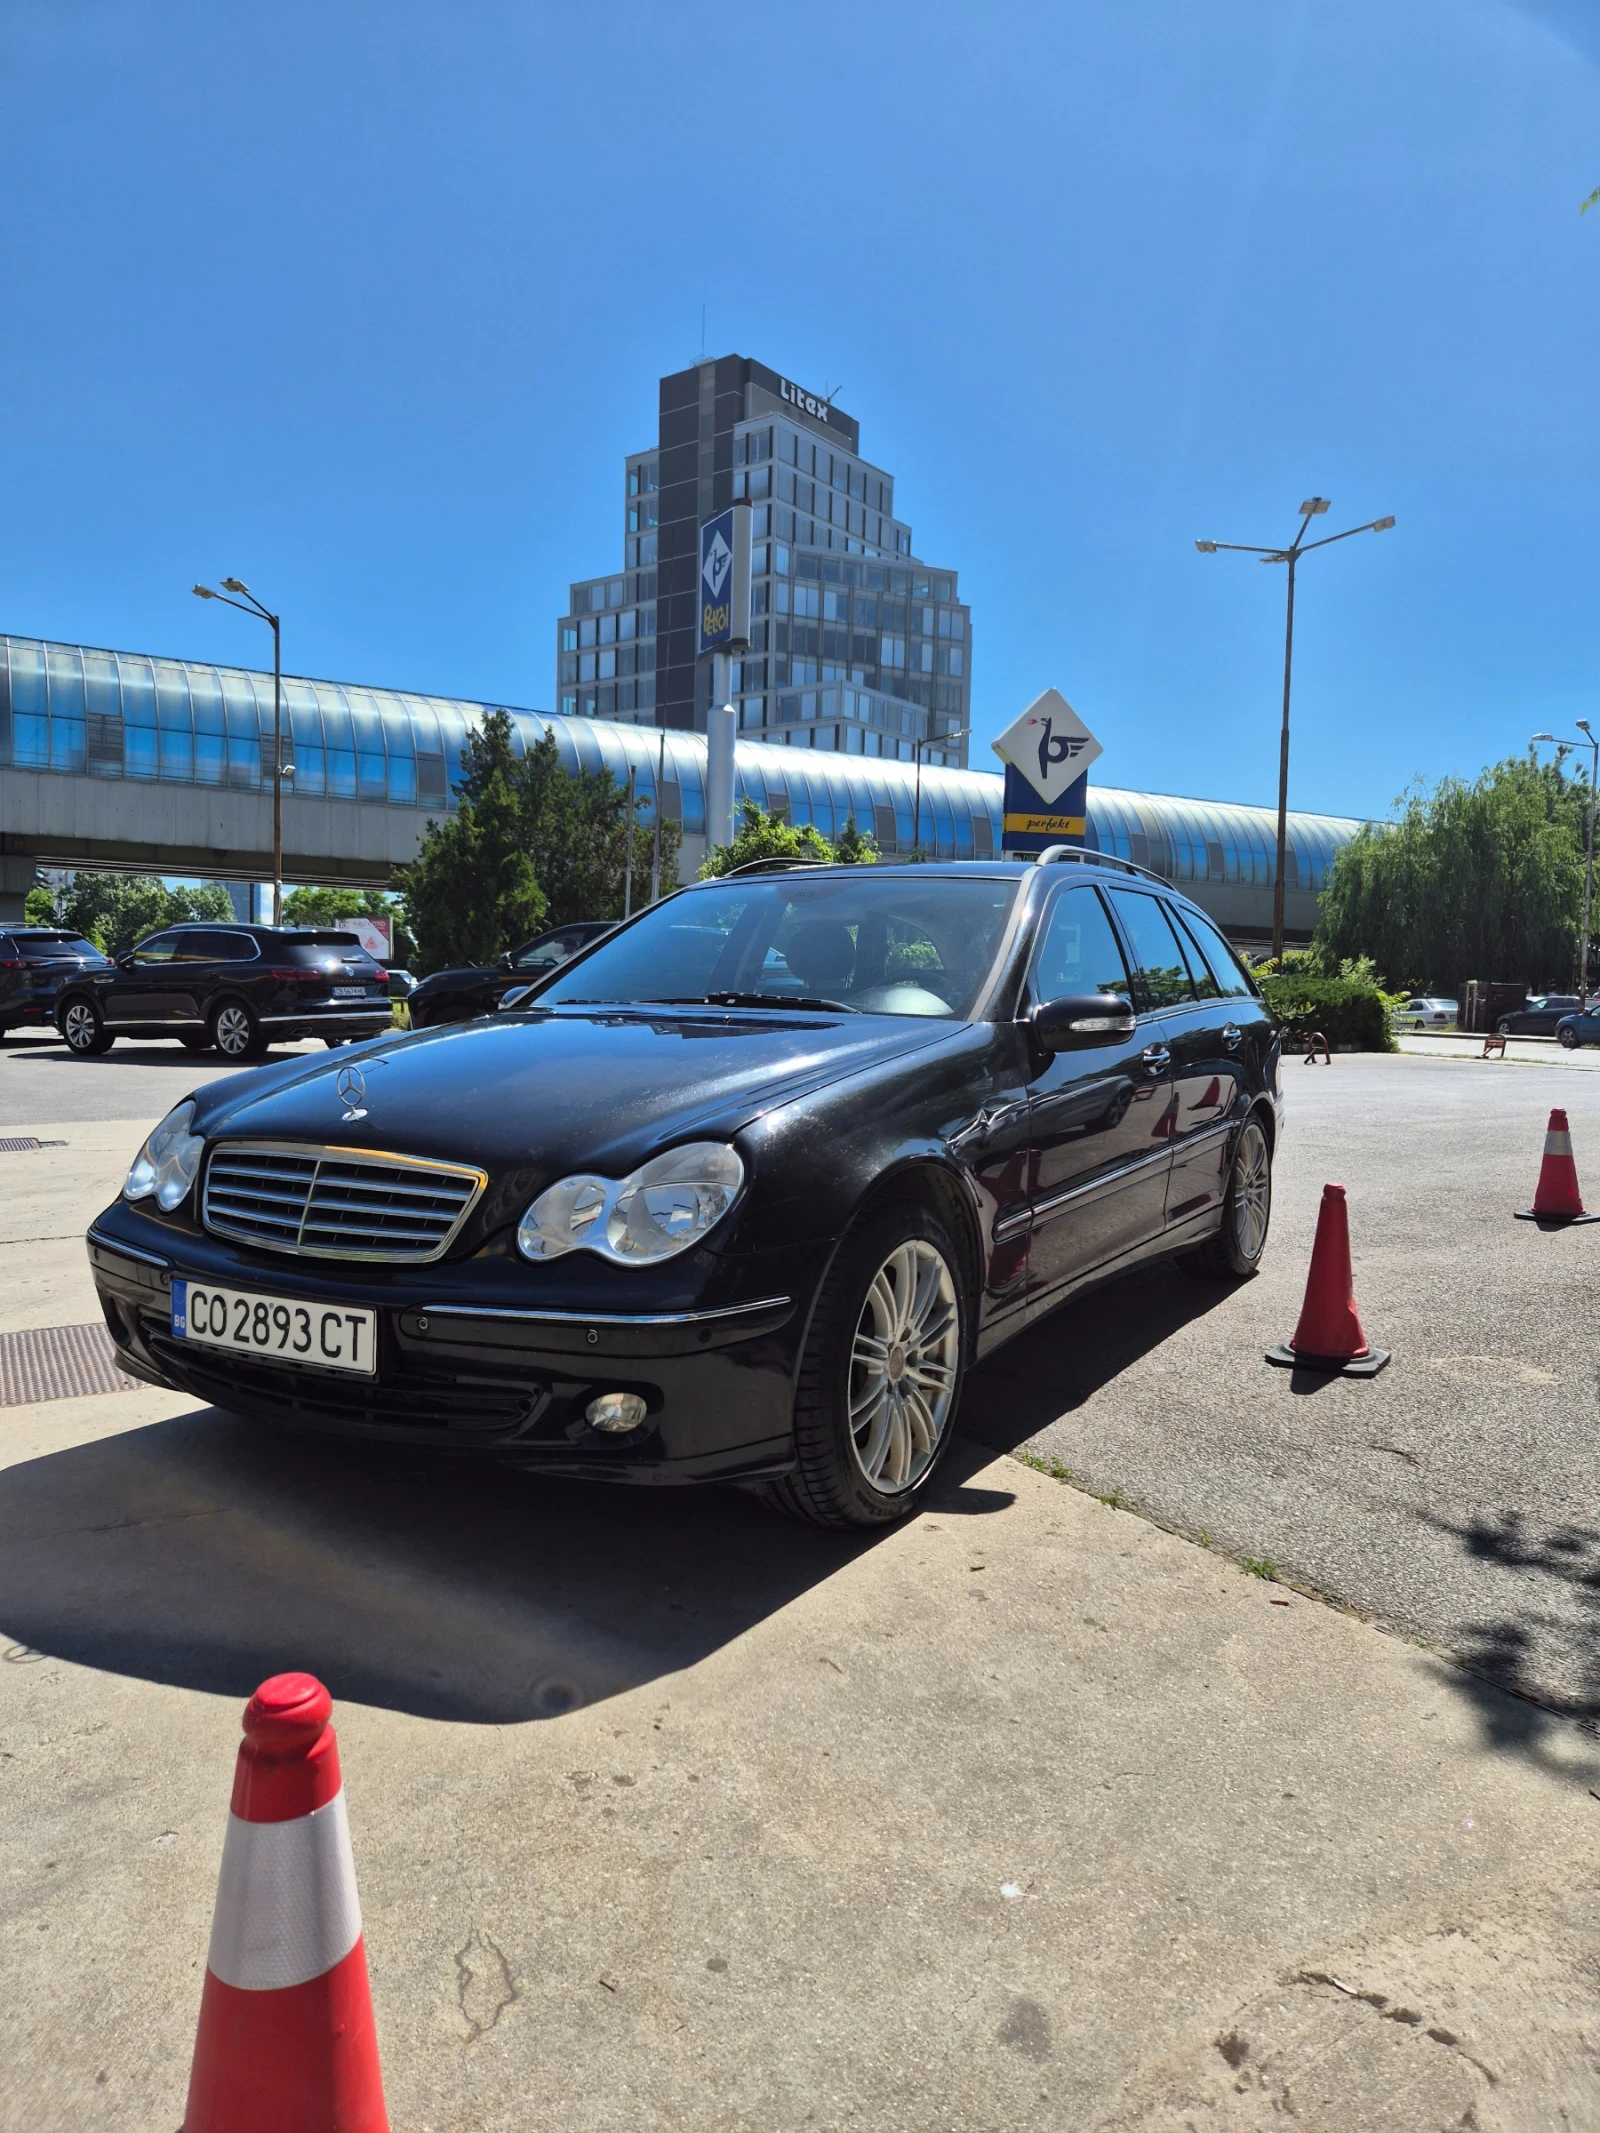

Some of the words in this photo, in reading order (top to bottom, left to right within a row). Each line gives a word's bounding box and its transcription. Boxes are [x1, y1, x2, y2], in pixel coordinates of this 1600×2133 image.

[1026, 817, 1070, 831] perfekt
[174, 1314, 186, 1328] BG
[233, 1298, 312, 1353] 2893
